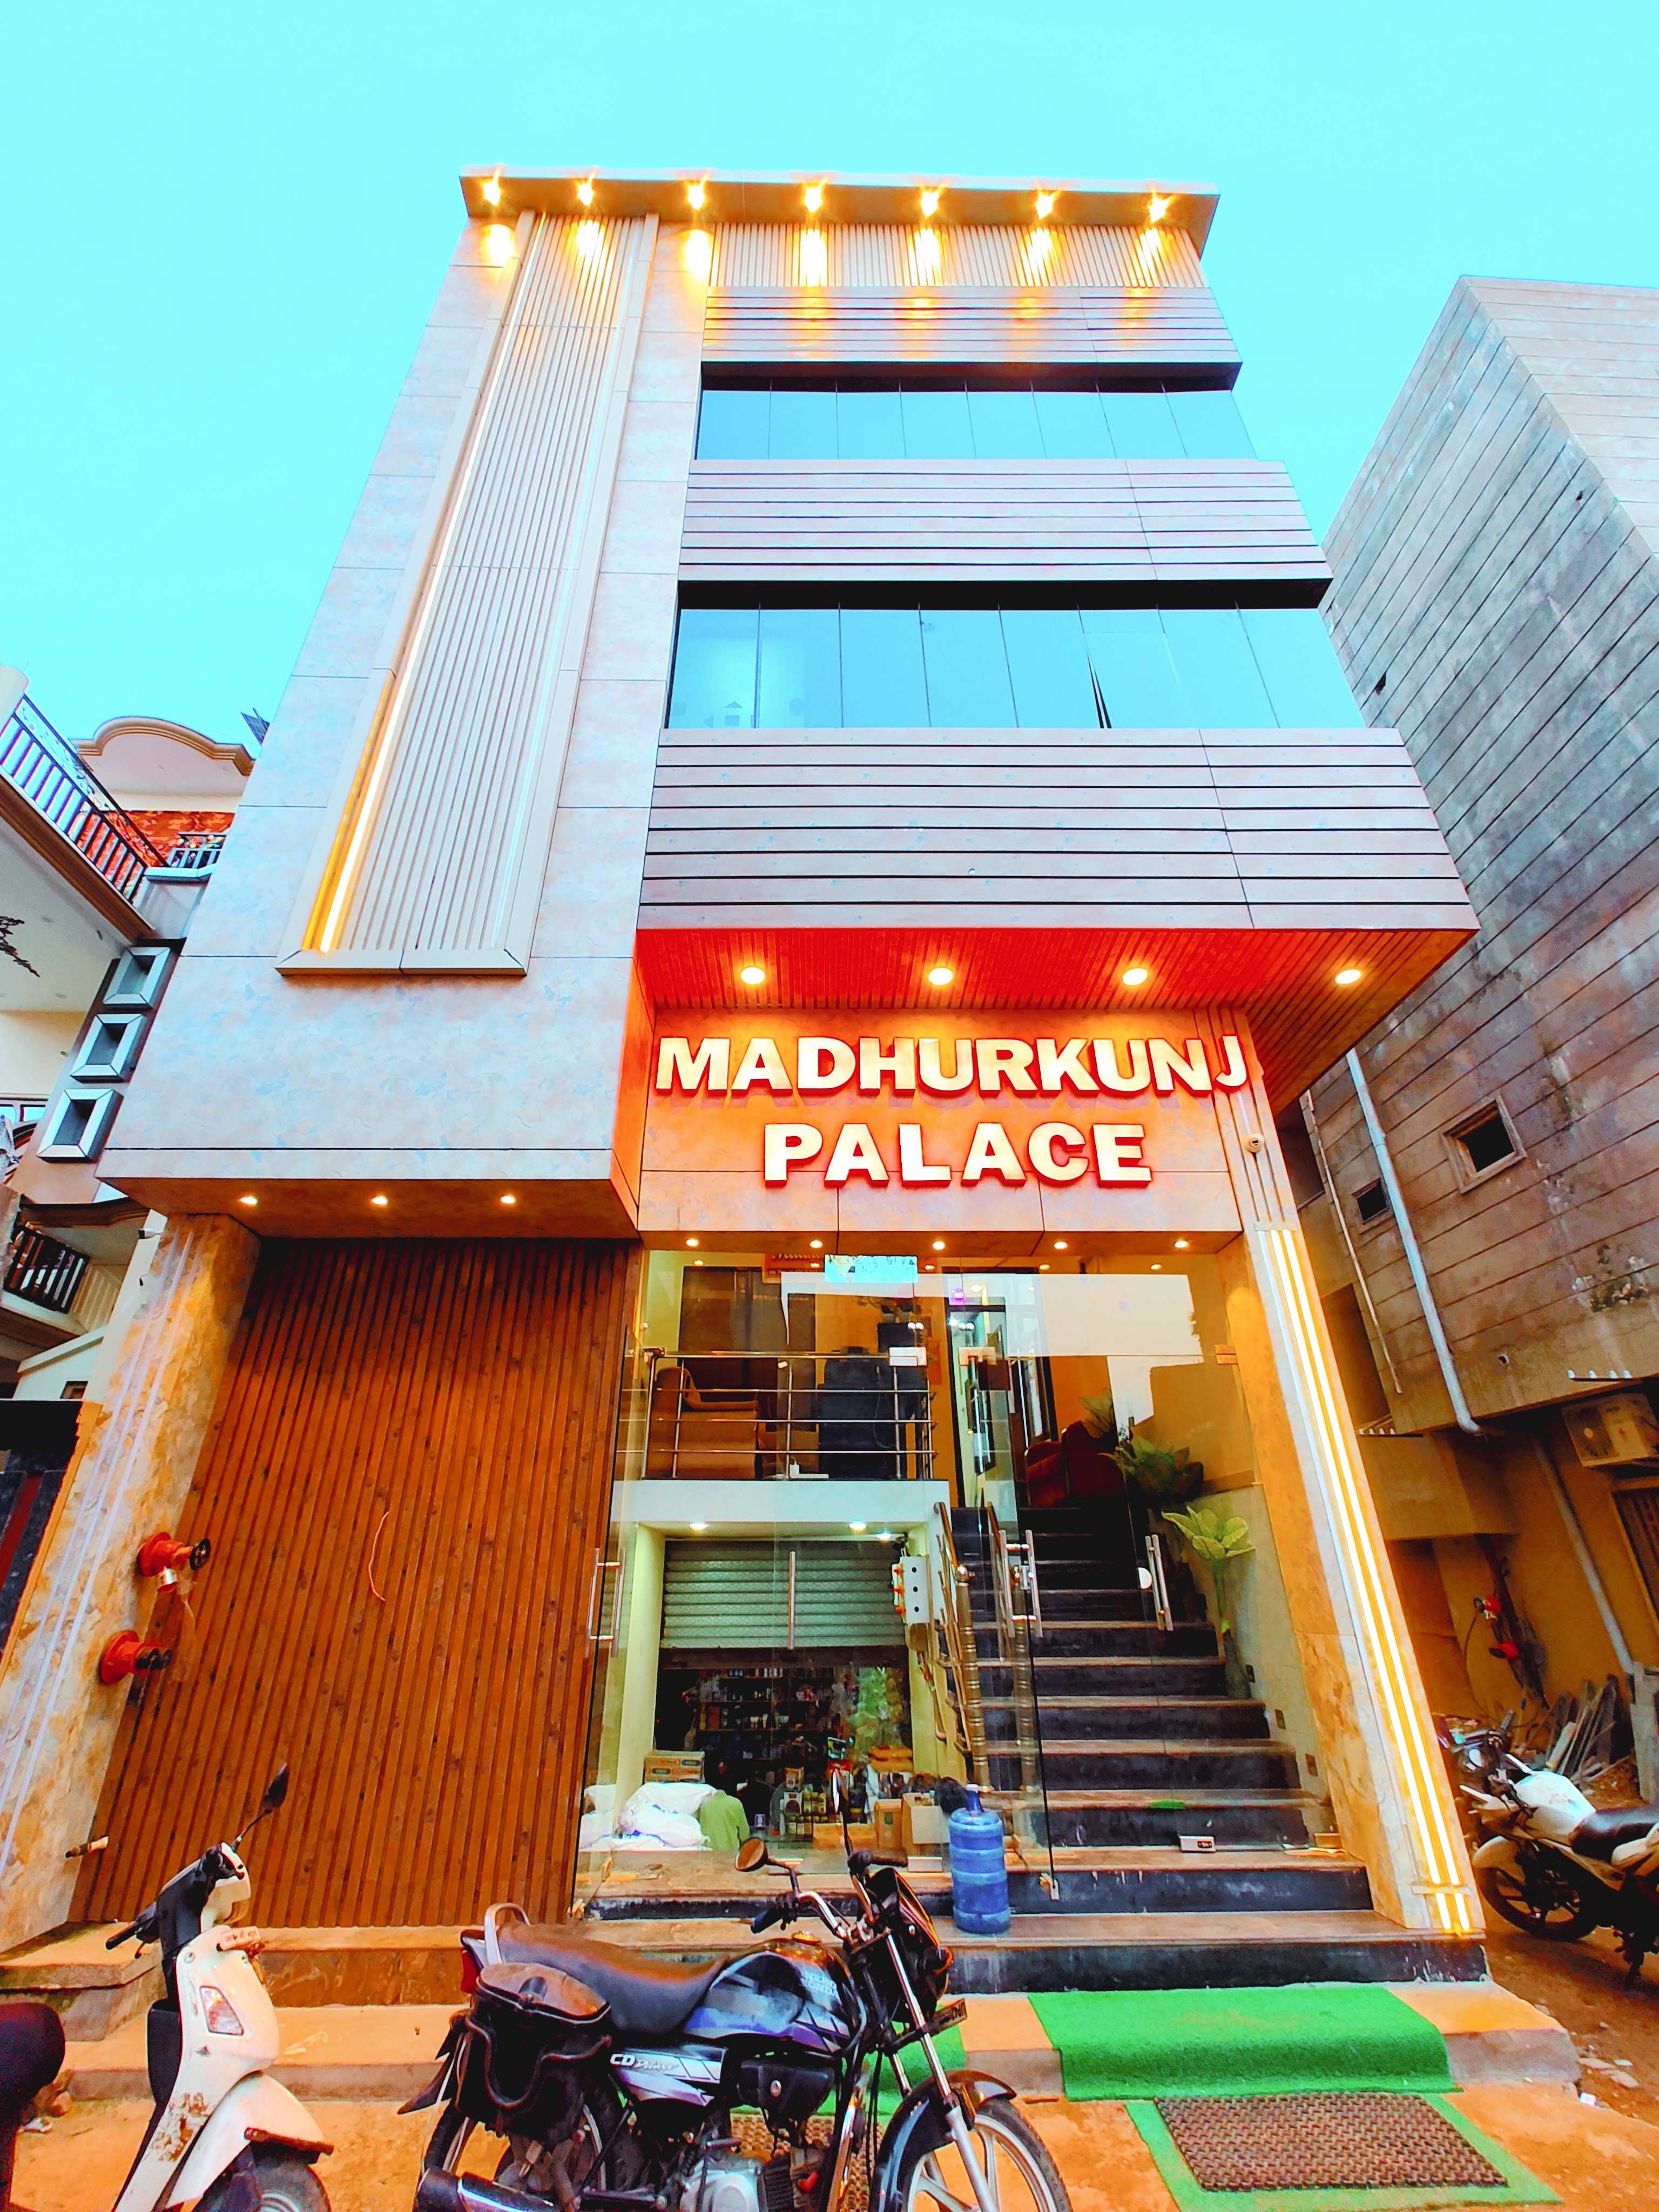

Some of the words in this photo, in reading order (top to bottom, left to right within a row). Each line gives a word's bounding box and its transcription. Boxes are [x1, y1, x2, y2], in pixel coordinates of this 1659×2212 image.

[655, 1035, 1249, 1095] MADHURKUNJ
[764, 1122, 1152, 1186] PALACE
[610, 2053, 636, 2067] CD
